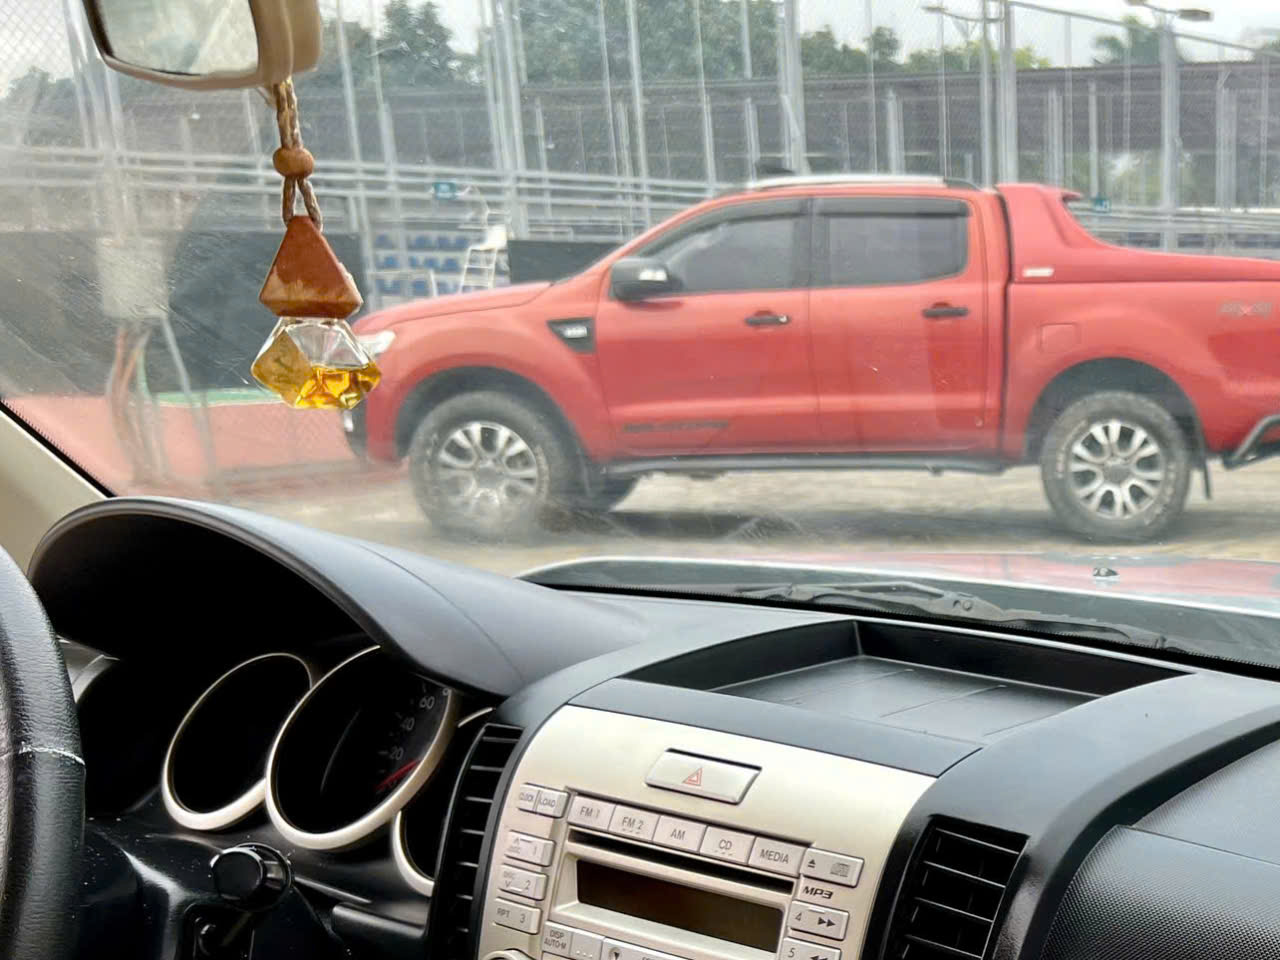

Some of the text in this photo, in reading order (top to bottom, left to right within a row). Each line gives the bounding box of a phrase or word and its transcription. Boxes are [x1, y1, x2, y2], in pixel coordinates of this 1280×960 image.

[420, 696, 435, 709] 60
[580, 806, 593, 817] FM
[622, 816, 645, 830] FM 2
[670, 828, 686, 840] AM
[718, 838, 733, 850] CD
[759, 848, 790, 864] MEDIA
[525, 879, 532, 890] 2
[803, 885, 834, 900] MP3
[520, 913, 527, 924] 3
[794, 912, 802, 922] 4
[550, 930, 565, 940] DISP
[787, 947, 796, 958] 5
